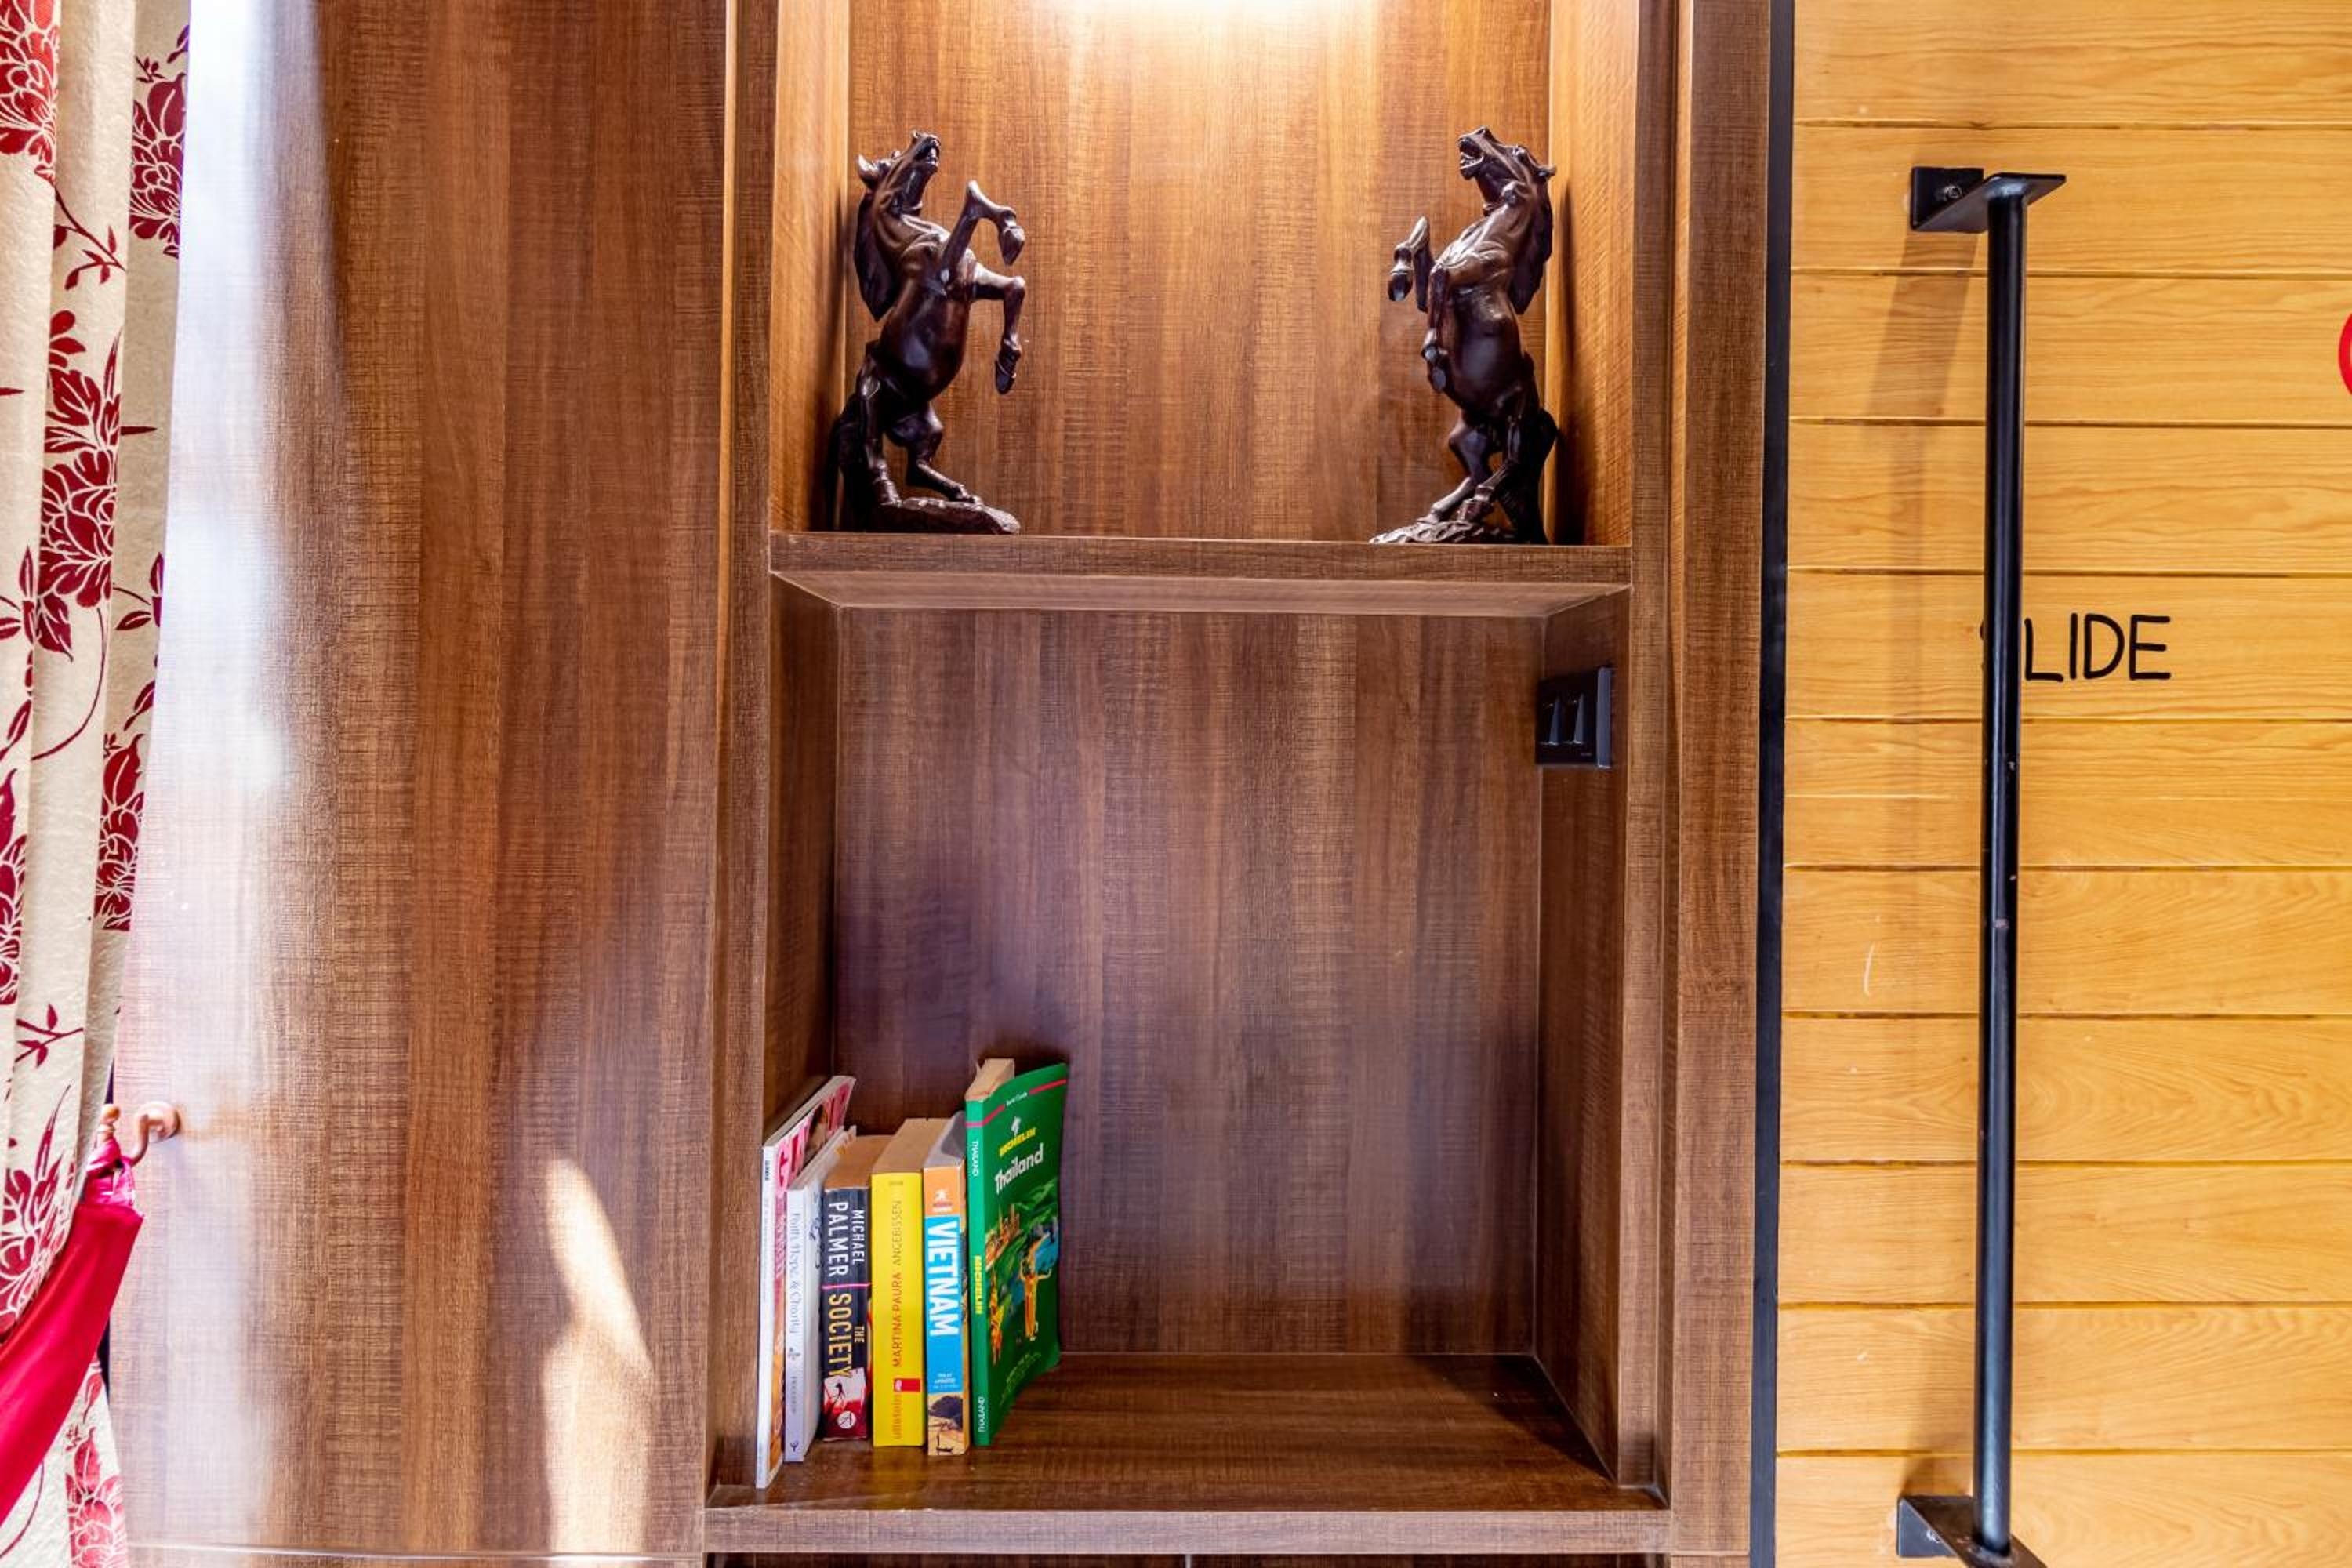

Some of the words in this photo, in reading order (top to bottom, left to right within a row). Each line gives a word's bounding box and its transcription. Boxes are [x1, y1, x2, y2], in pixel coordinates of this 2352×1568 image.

[1979, 613, 2171, 681] LIDE
[994, 1142, 1044, 1195] Thailand
[828, 1201, 849, 1277] PALMER
[852, 1210, 865, 1265] MICHAEL
[891, 1200, 902, 1267] ANGEBISSEN
[891, 1272, 902, 1312] PAURA
[927, 1220, 960, 1337] VIETNAM
[828, 1293, 852, 1377] SOCIETY
[853, 1325, 865, 1343] THE
[891, 1314, 902, 1367] MARTINA
